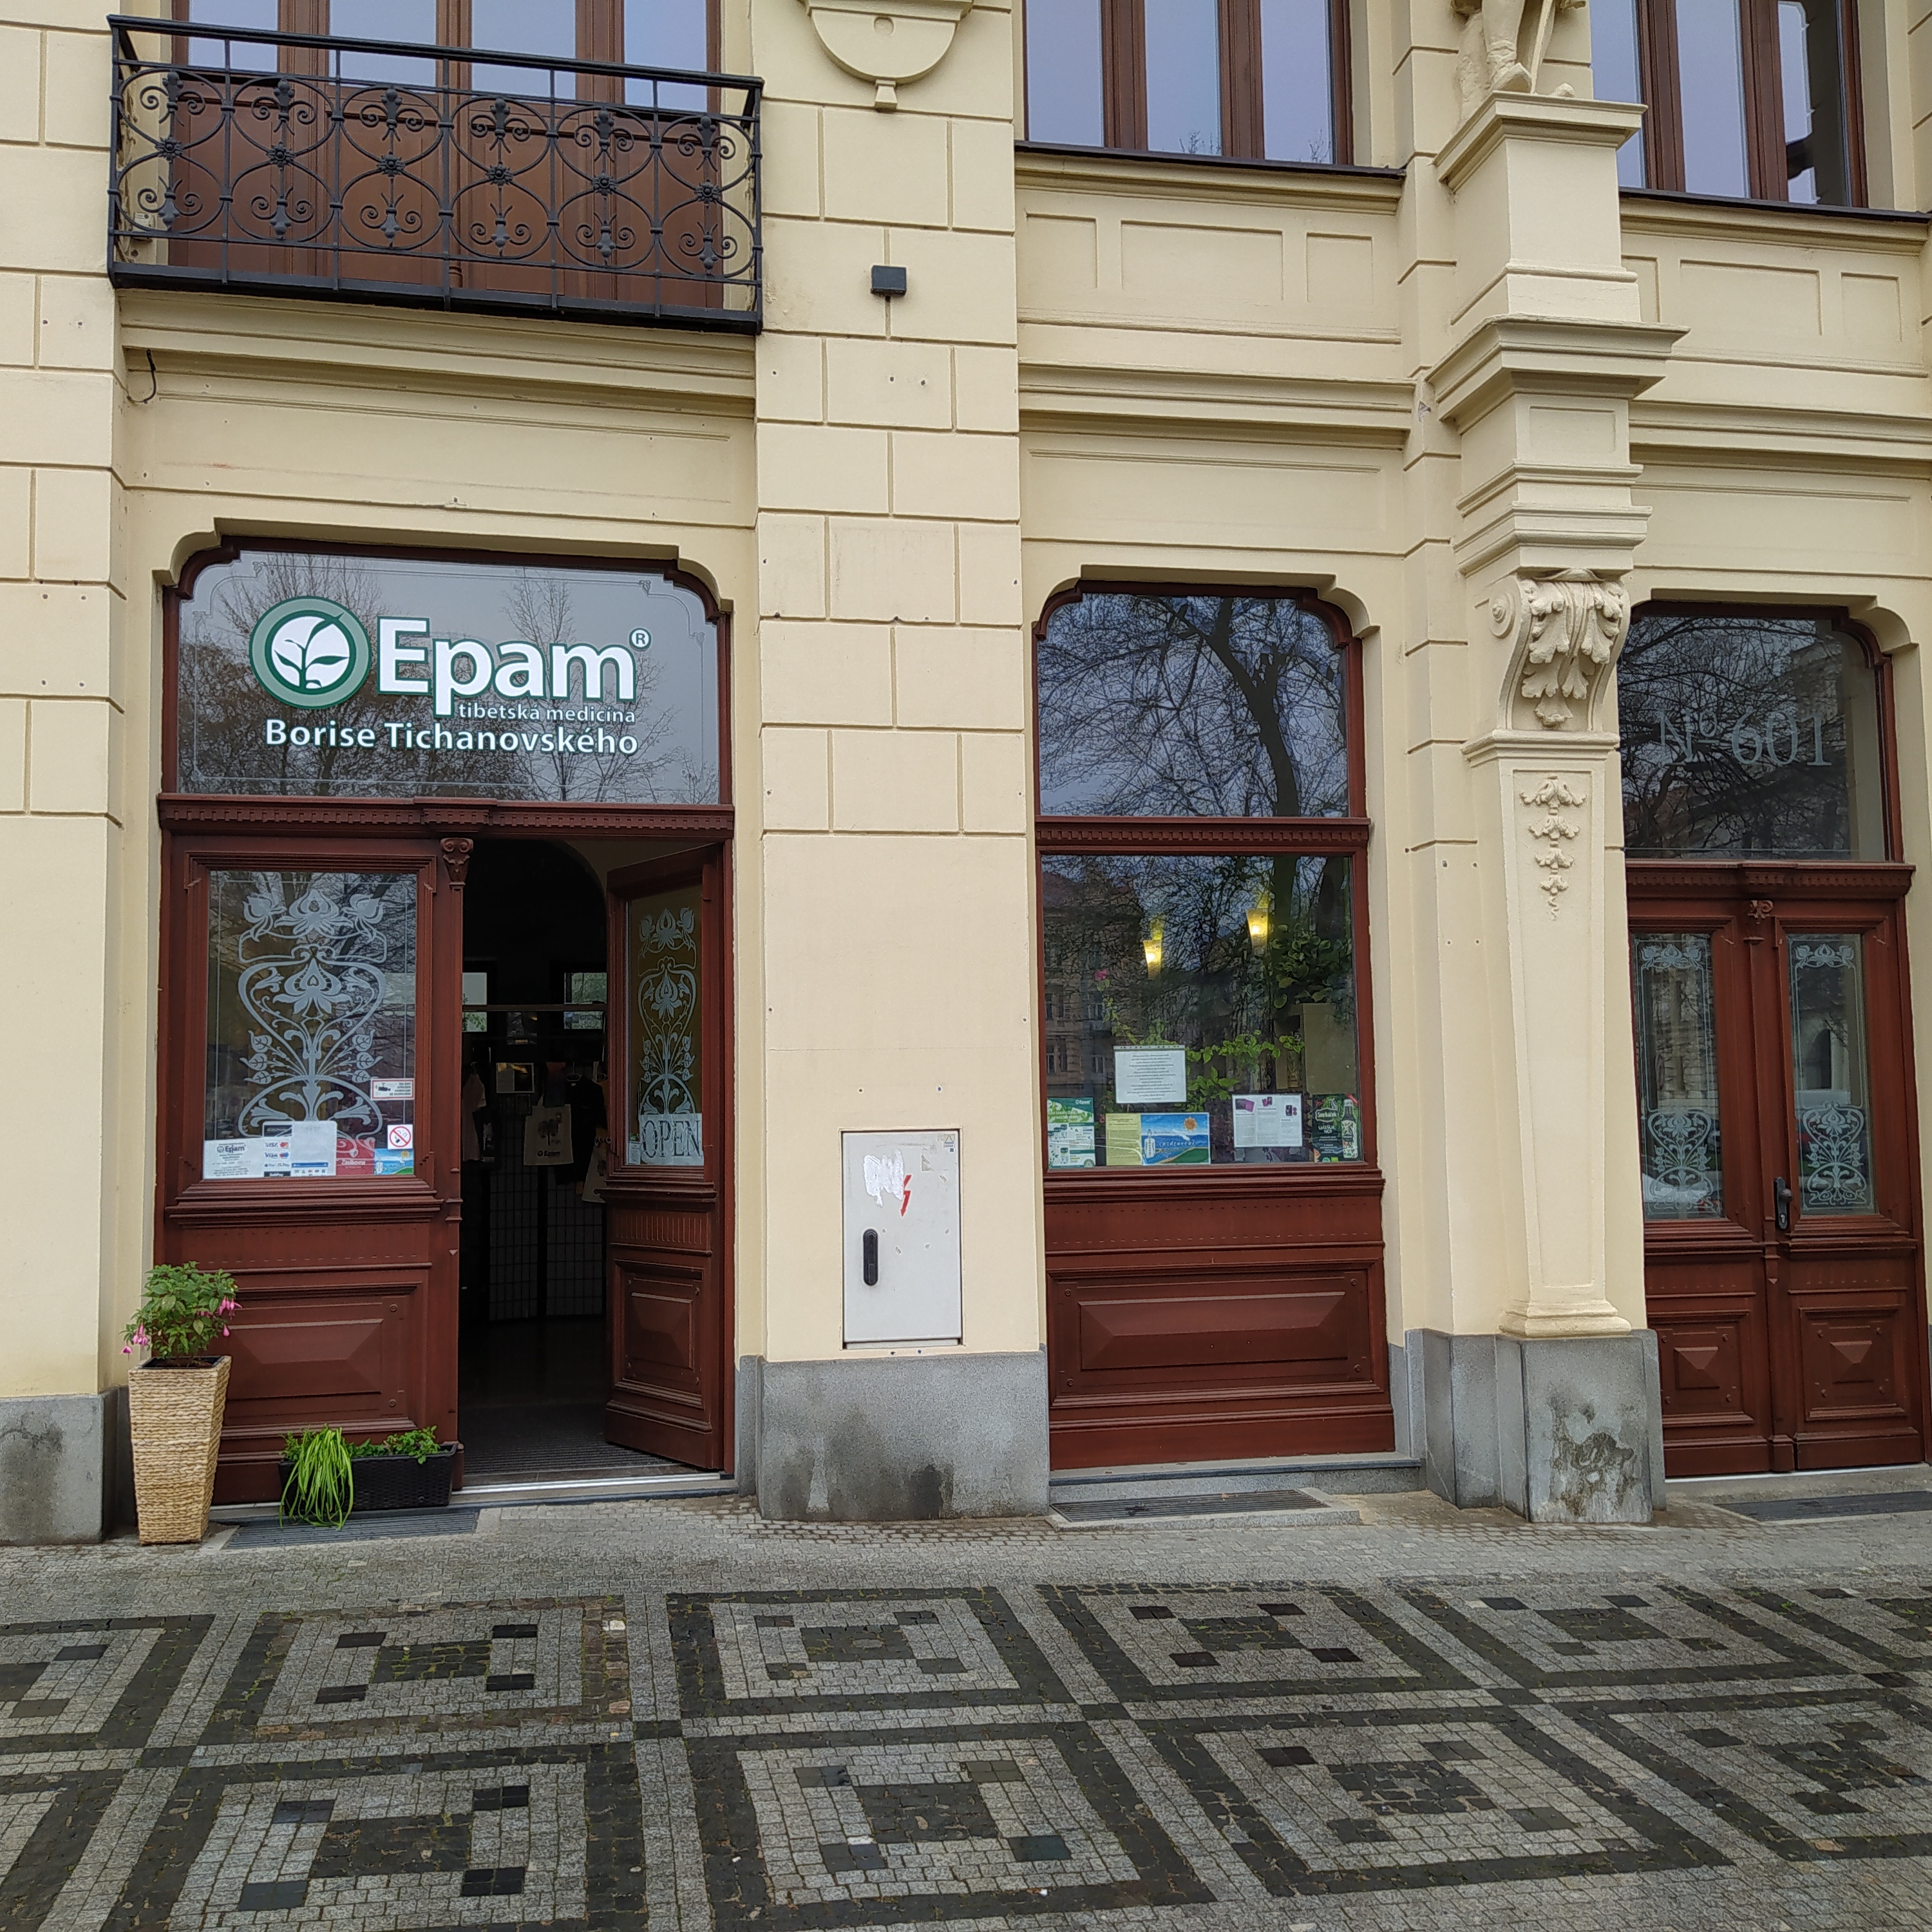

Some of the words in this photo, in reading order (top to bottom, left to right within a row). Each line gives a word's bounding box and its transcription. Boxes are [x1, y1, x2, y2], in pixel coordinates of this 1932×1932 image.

[377, 616, 637, 717] Epam
[458, 702, 540, 720] tibetská
[547, 706, 636, 723] medicína
[265, 719, 376, 748] Borise
[384, 722, 638, 755] Tichanovského
[1731, 708, 1832, 766] 601
[642, 1120, 701, 1159] OPEN
